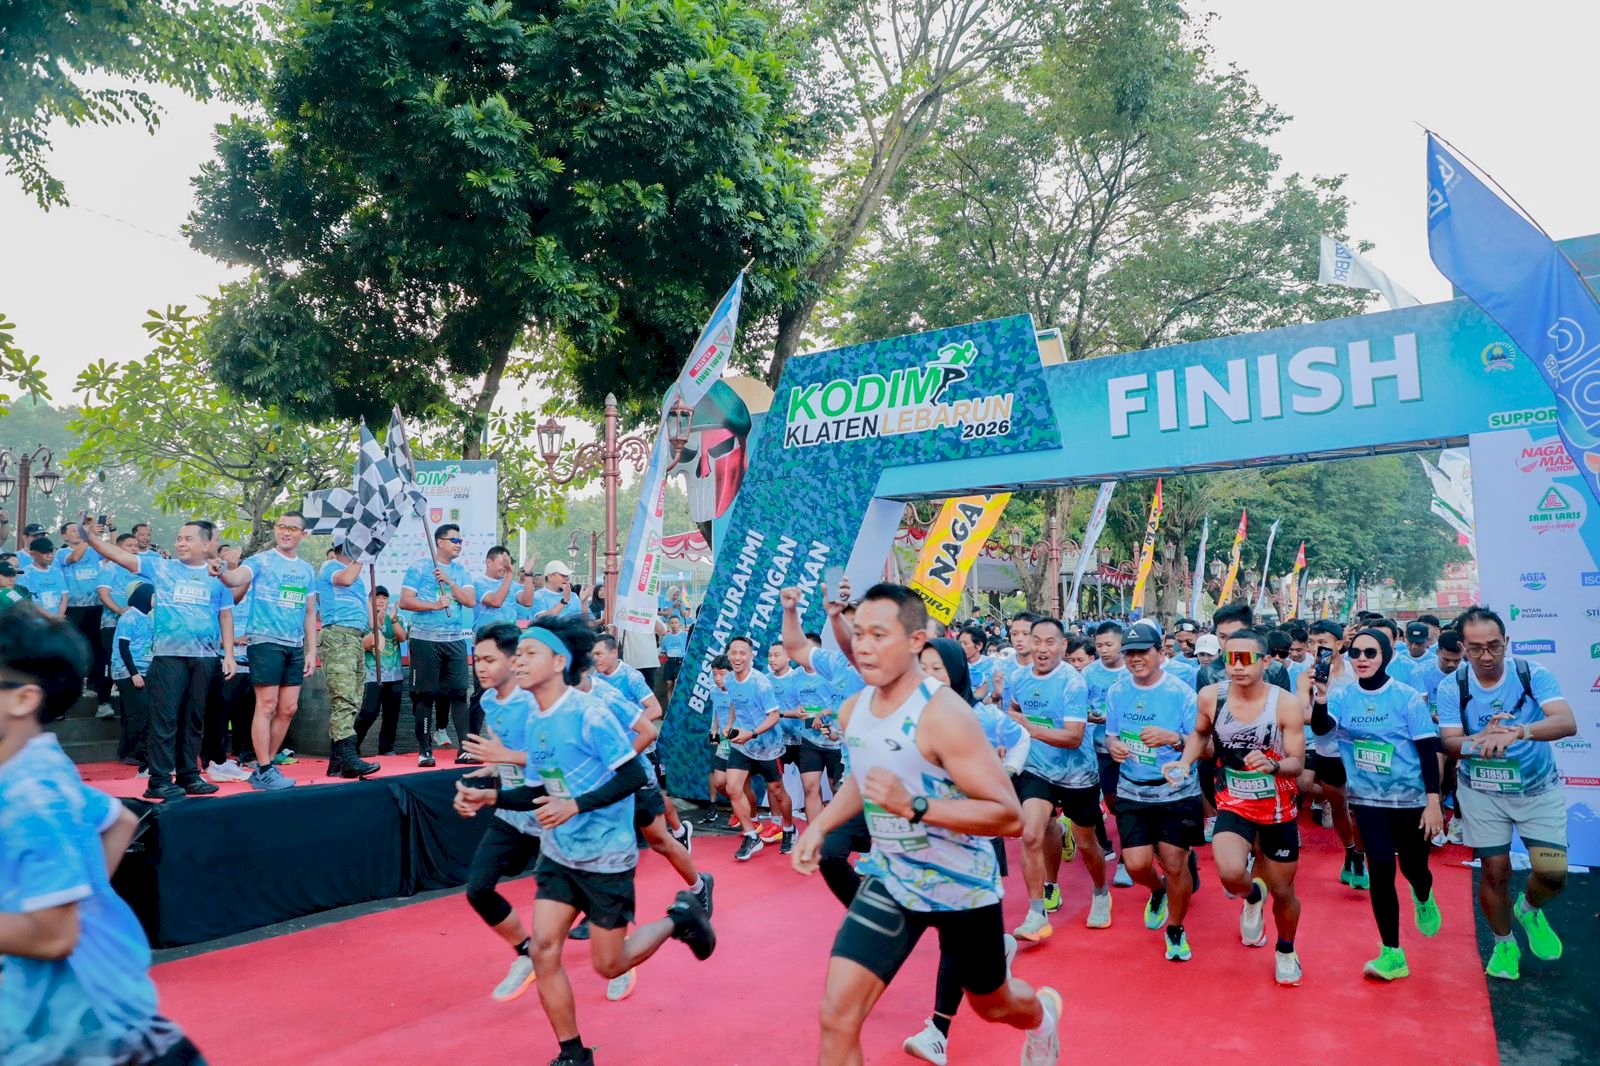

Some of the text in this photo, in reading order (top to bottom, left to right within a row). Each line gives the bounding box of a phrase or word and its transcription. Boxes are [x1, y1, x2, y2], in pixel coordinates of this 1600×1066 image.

[1107, 332, 1423, 438] FINISH
[787, 367, 941, 423] KODIM
[785, 394, 1014, 447] KLATEN LEBARUN
[1490, 409, 1558, 426] SUPPOR
[963, 420, 1011, 438] 2026
[1521, 445, 1565, 458] NAGA
[1539, 455, 1573, 467] MAS
[1545, 464, 1575, 472] MOTOR
[416, 472, 448, 486] DIM
[1529, 511, 1582, 522] SAMI LARIS
[927, 502, 985, 587] NAGA
[750, 534, 798, 630] TANGAN
[1519, 572, 1547, 582] AQUA
[1514, 642, 1553, 653] Salonpas
[1350, 715, 1385, 724] KODIM
[1222, 741, 1247, 749] THE
[1361, 750, 1383, 762] 51857
[1479, 768, 1510, 780] 51856
[1233, 779, 1265, 790] 50093
